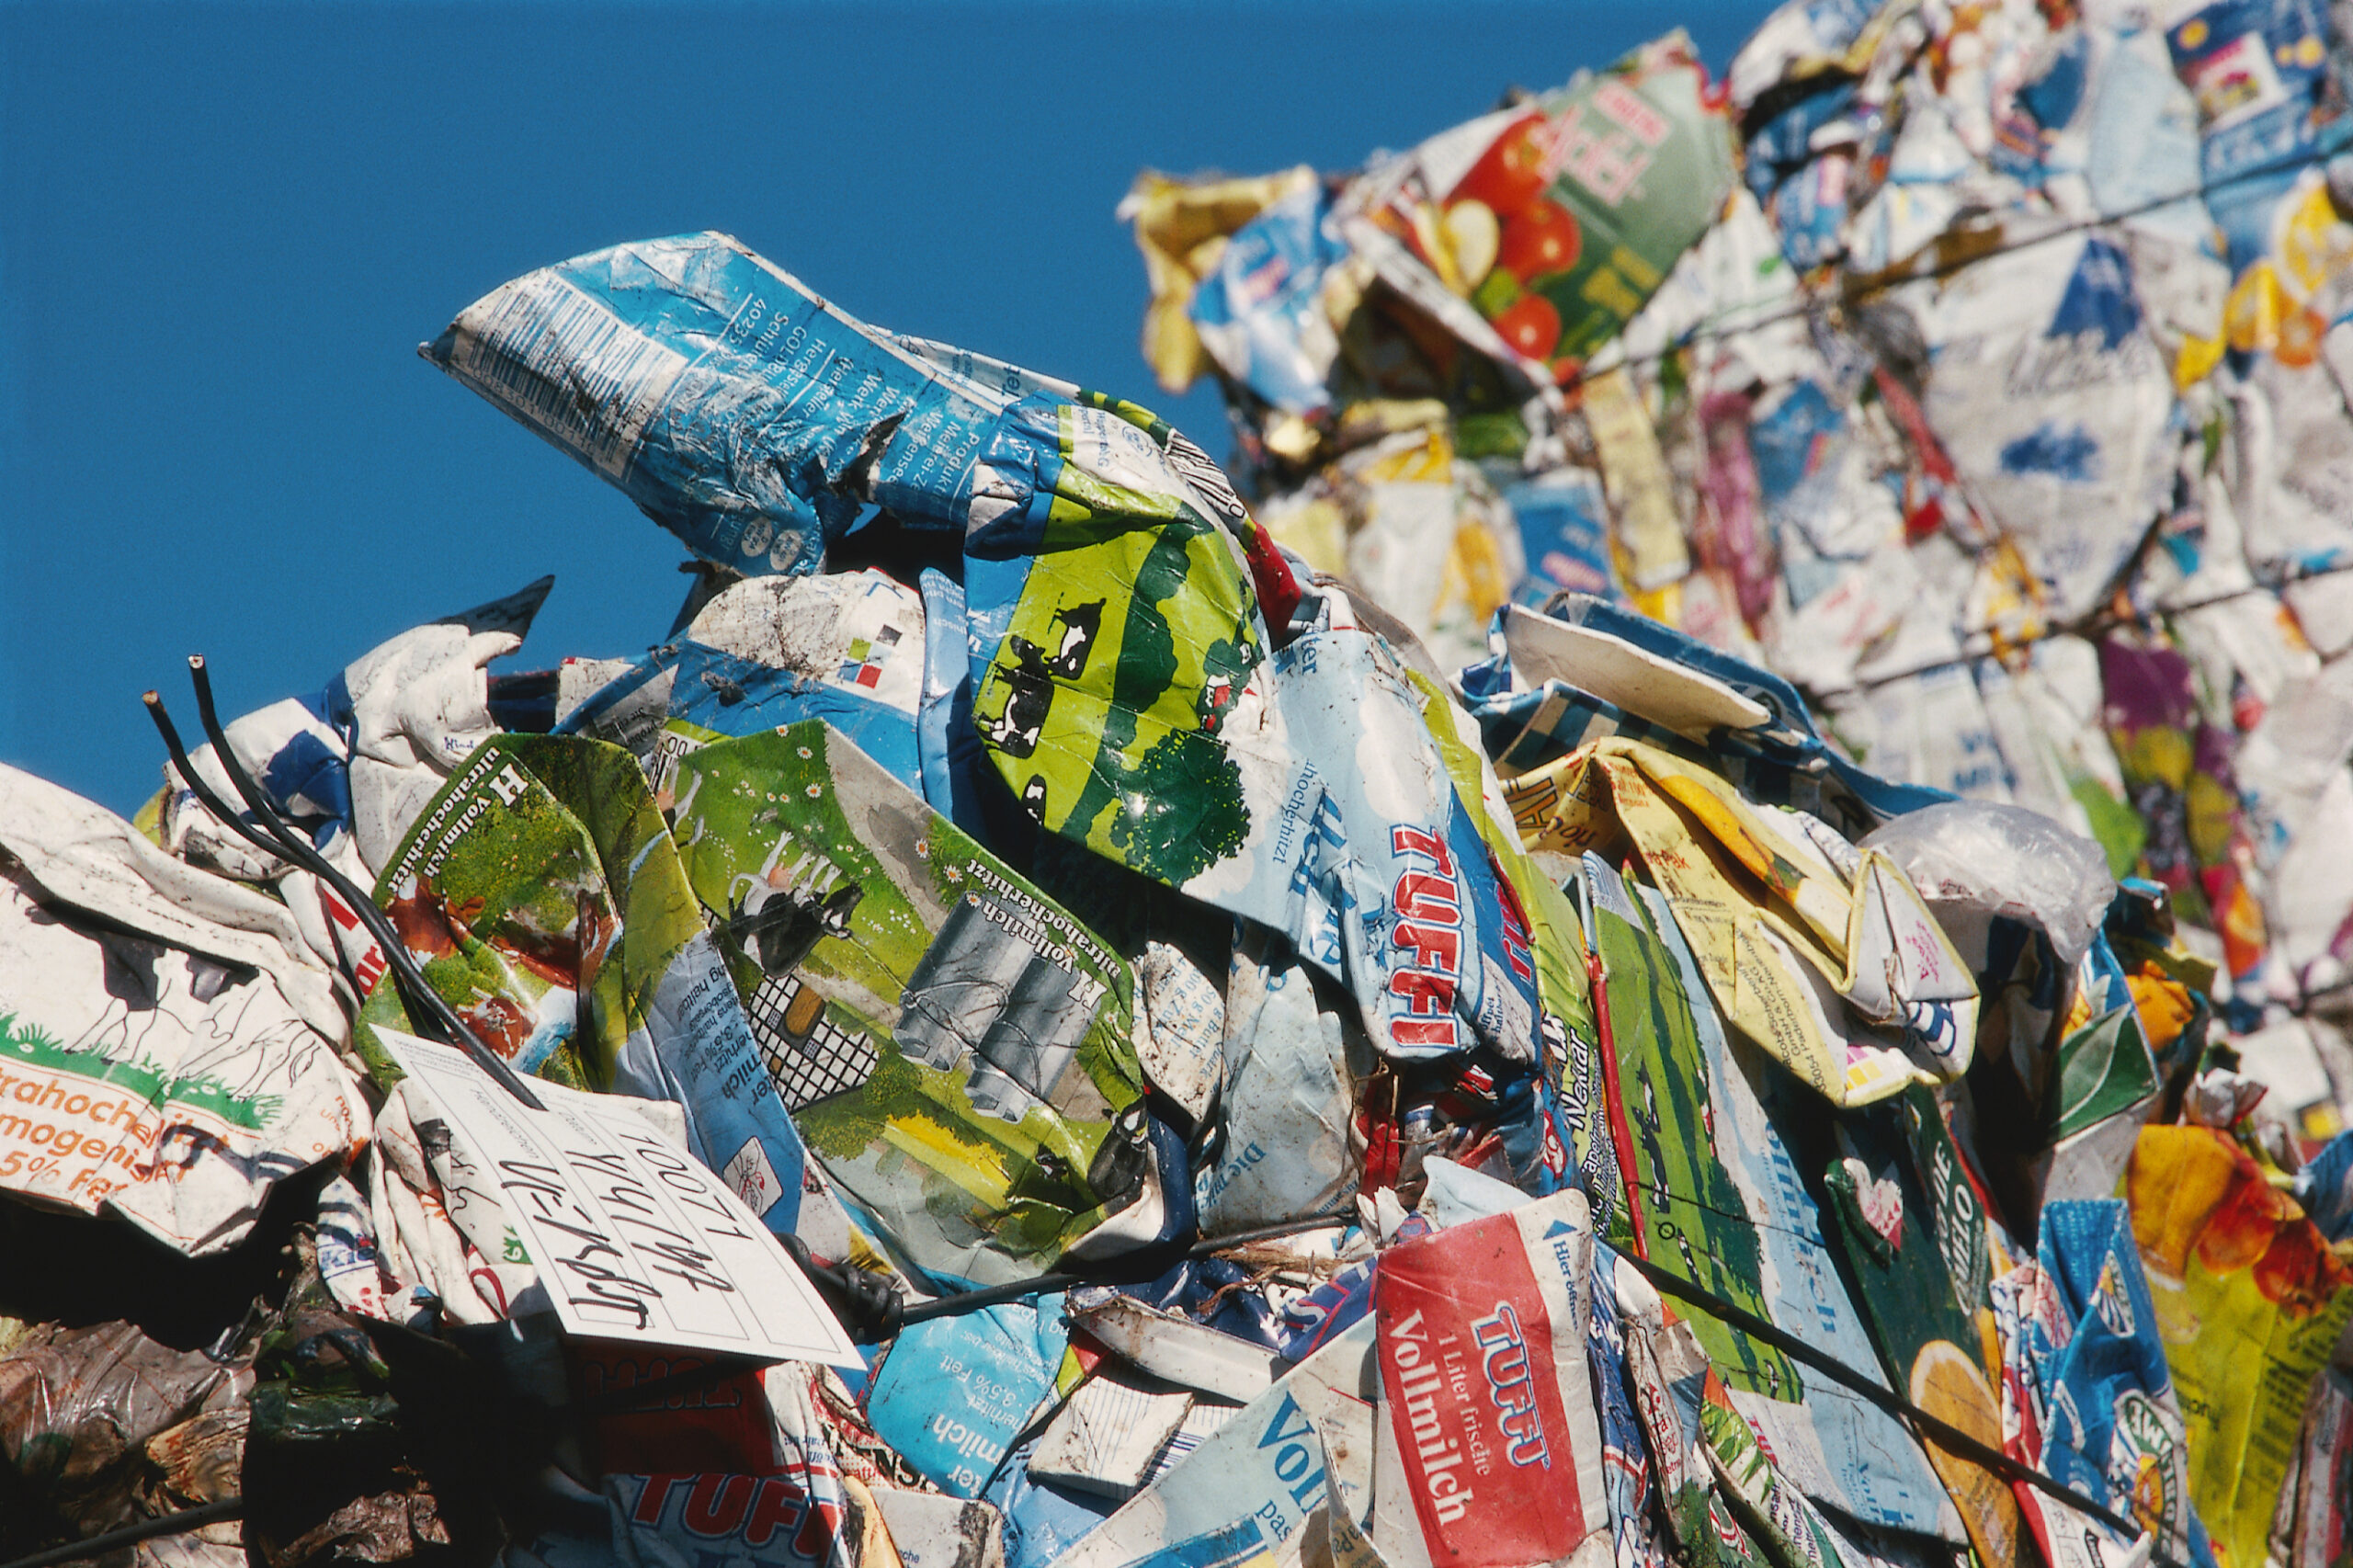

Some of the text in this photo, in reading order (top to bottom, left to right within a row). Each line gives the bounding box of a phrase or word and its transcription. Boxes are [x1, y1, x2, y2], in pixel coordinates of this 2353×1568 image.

[727, 297, 768, 349] 40235
[887, 410, 944, 486] Weißensee
[908, 420, 962, 494] Meierei-Ze
[386, 745, 502, 893] ultrahocherhitzt
[421, 761, 533, 879] H Vollmilch
[1272, 760, 1318, 865] hocherhitzt
[964, 858, 1122, 980] ultrahocherhitzt
[978, 900, 1075, 975] Vollmilch
[1390, 824, 1462, 1050] TUFFI
[1065, 969, 1108, 1012] H
[1188, 1019, 1221, 1058] Butter
[1808, 1055, 1826, 1092] 33054
[1561, 1028, 1589, 1131] Nektar
[620, 1134, 753, 1239] 10071
[1226, 1141, 1267, 1178] Die
[1553, 1239, 1574, 1272] Hier
[939, 1353, 972, 1381] Fett
[1469, 1298, 1551, 1472] TUFFI
[934, 1415, 1006, 1465] milch
[1385, 1309, 1476, 1527] Vollmilch
[1442, 1350, 1473, 1404] Liter
[1458, 1405, 1492, 1477] frische
